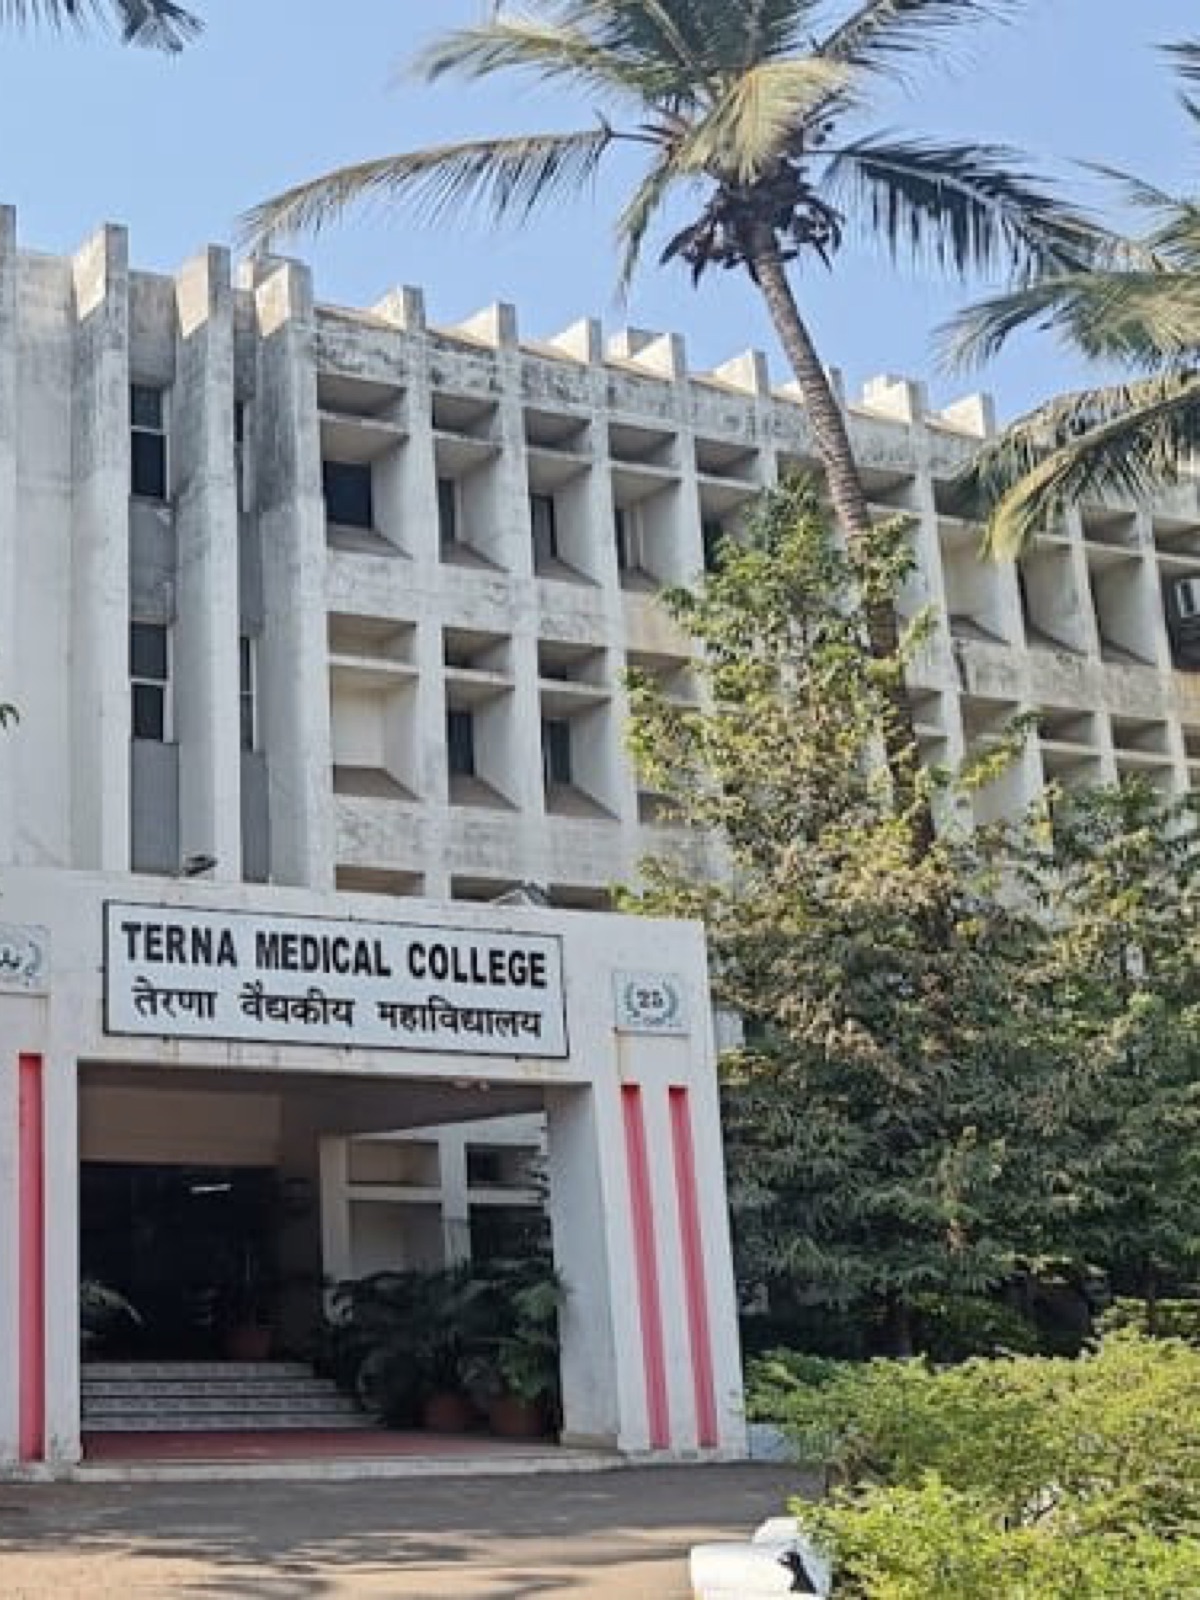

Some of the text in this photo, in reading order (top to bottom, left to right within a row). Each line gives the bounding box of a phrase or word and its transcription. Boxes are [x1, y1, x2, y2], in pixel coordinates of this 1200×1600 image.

[121, 921, 547, 988] TERNA MEDICAL COLLEGE
[131, 975, 543, 1037] तेरणा वैद्यकीय महाविद्यालय
